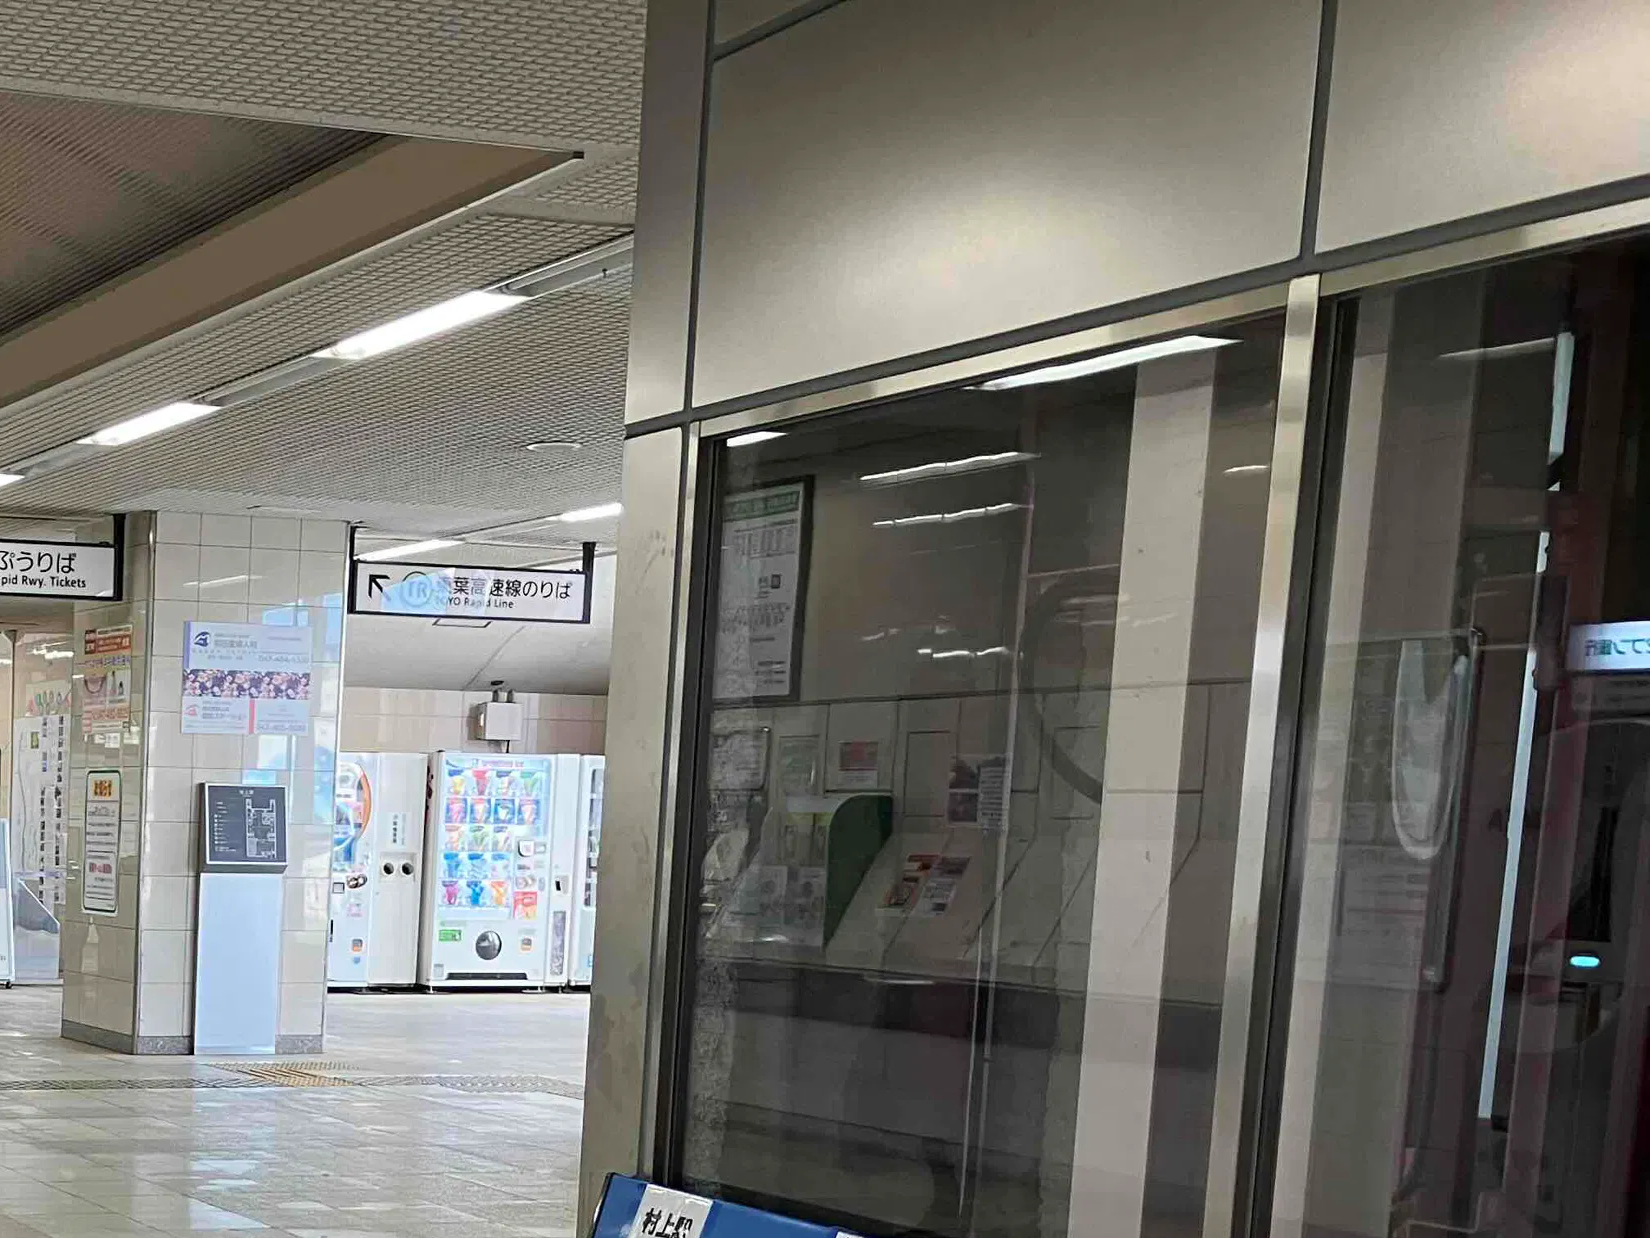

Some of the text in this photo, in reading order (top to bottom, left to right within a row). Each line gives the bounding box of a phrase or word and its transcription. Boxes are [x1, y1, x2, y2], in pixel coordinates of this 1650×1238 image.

[21, 575, 47, 588] Rwy.
[50, 576, 86, 589] Tickets
[494, 599, 514, 608] Line
